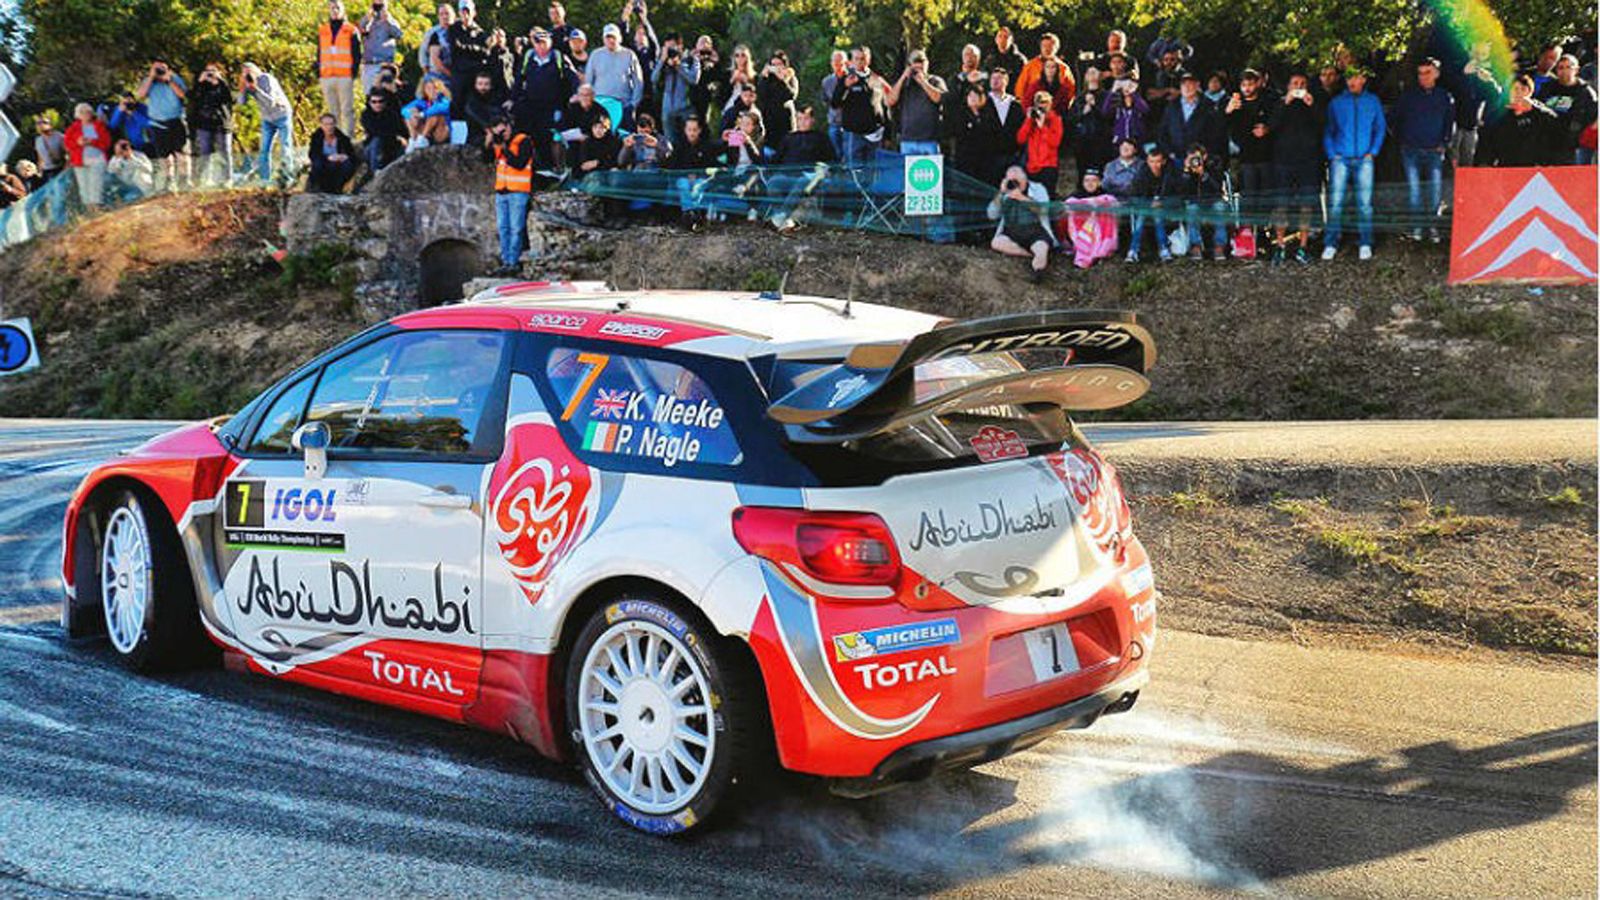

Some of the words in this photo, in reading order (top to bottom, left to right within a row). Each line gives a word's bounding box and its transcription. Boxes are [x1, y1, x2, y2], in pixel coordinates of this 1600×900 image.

[560, 353, 610, 421] 7
[624, 392, 646, 420] K.
[652, 394, 724, 429] Meeke
[615, 425, 631, 453] P.
[639, 430, 700, 466] Nagle
[237, 484, 250, 523] 7
[271, 488, 337, 522] IGOL
[875, 623, 956, 648] MICHELIN
[1043, 628, 1063, 673] 7
[363, 650, 464, 696] TOTAL
[853, 655, 958, 689] TOTAL
